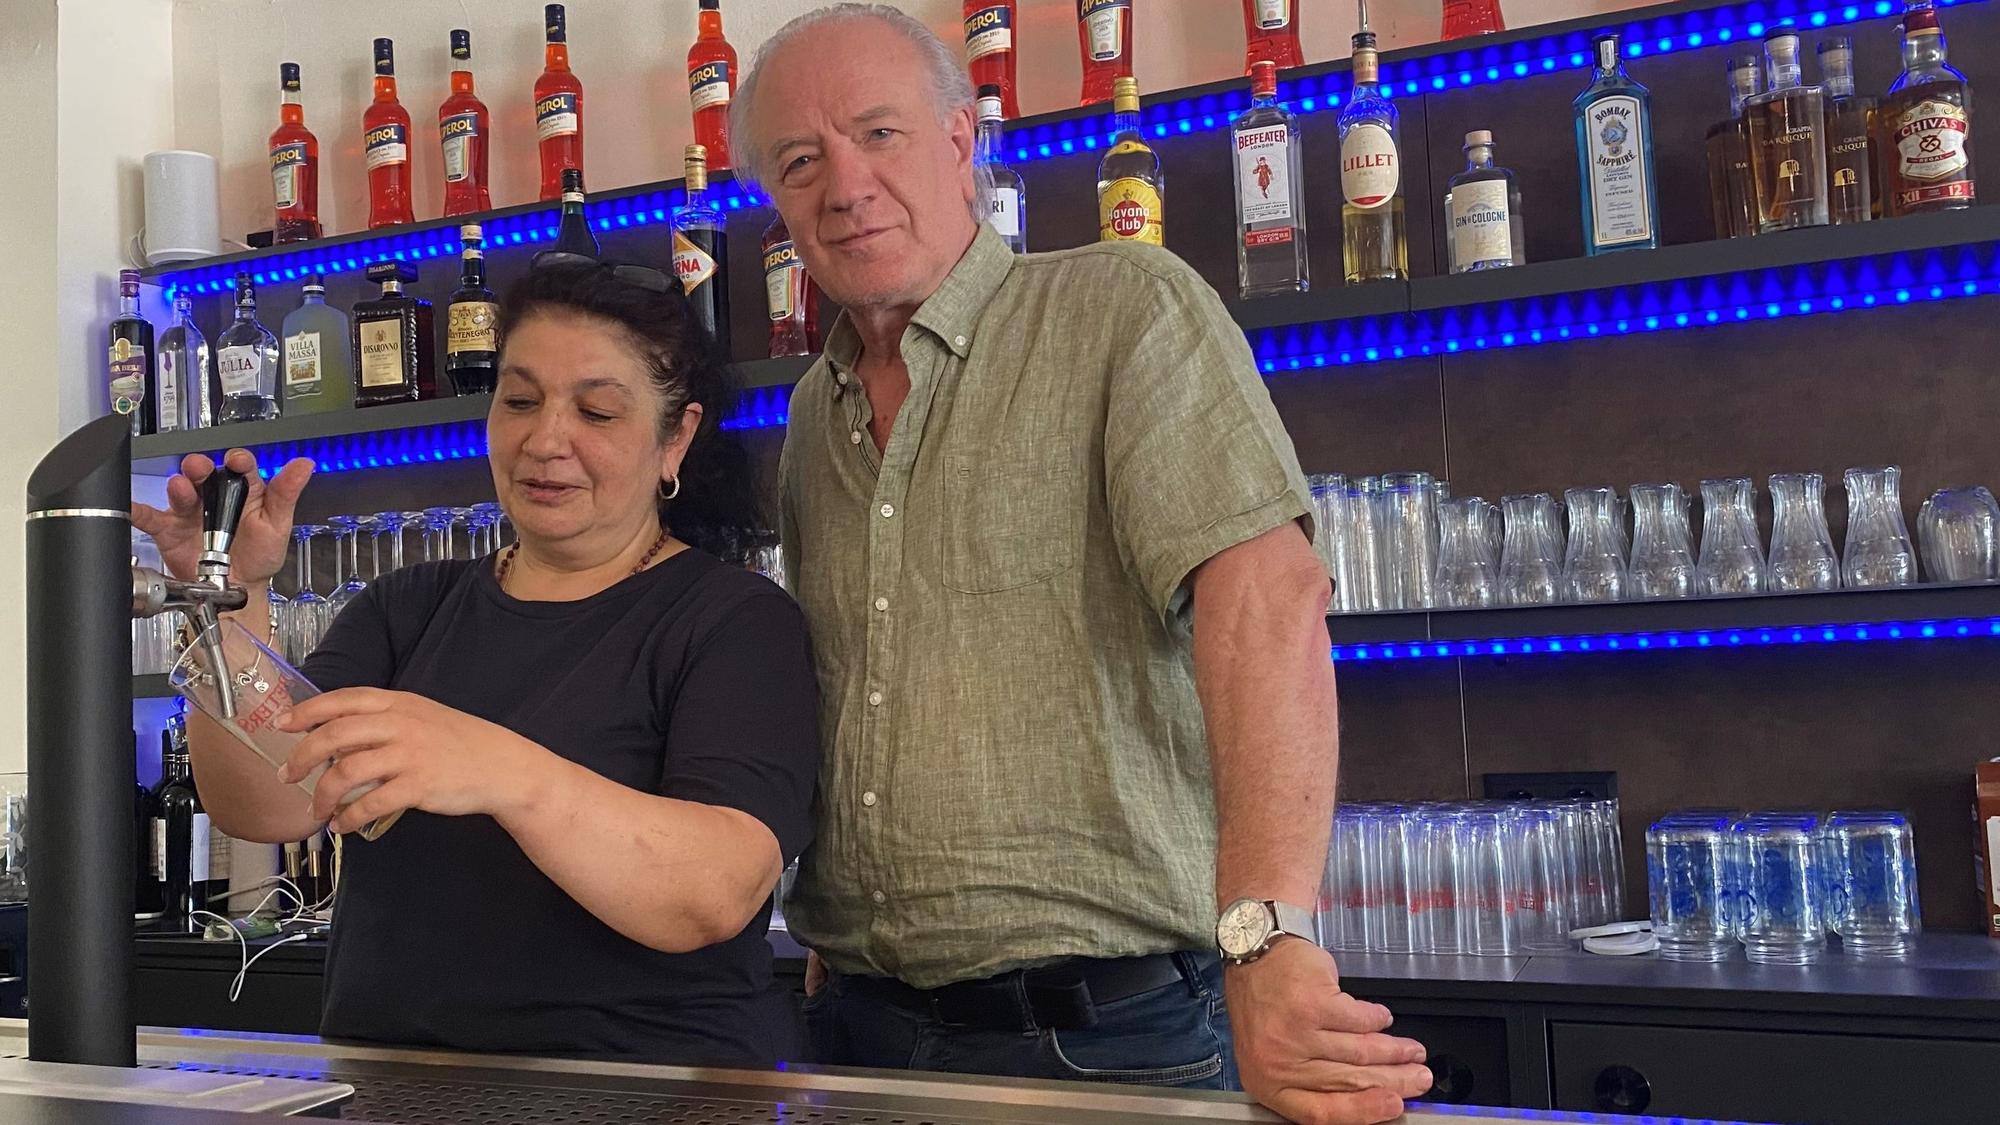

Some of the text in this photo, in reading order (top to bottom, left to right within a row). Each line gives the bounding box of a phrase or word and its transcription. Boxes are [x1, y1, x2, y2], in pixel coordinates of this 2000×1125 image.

[965, 10, 1002, 34] PEROL
[689, 65, 719, 89] PEROL
[537, 96, 568, 117] PEROL
[1595, 106, 1631, 124] BOMBAY
[441, 119, 473, 141] PEROL
[1901, 118, 1958, 137] CHIVAS
[366, 127, 398, 147] PEROL
[1238, 129, 1286, 150] BEEFEATER
[271, 149, 302, 167] PEROL
[1343, 154, 1394, 172] LILLET
[1597, 150, 1636, 166] SAPPHIRE
[1902, 190, 1920, 204] XII
[1948, 184, 1963, 196] 12
[1108, 207, 1150, 220] Havana
[1114, 216, 1141, 232] Club
[764, 247, 798, 271] PEROL
[288, 349, 317, 360] MASSA
[290, 340, 314, 351] VILLA
[363, 342, 399, 354] DISARONNO
[220, 358, 254, 374] JULIA
